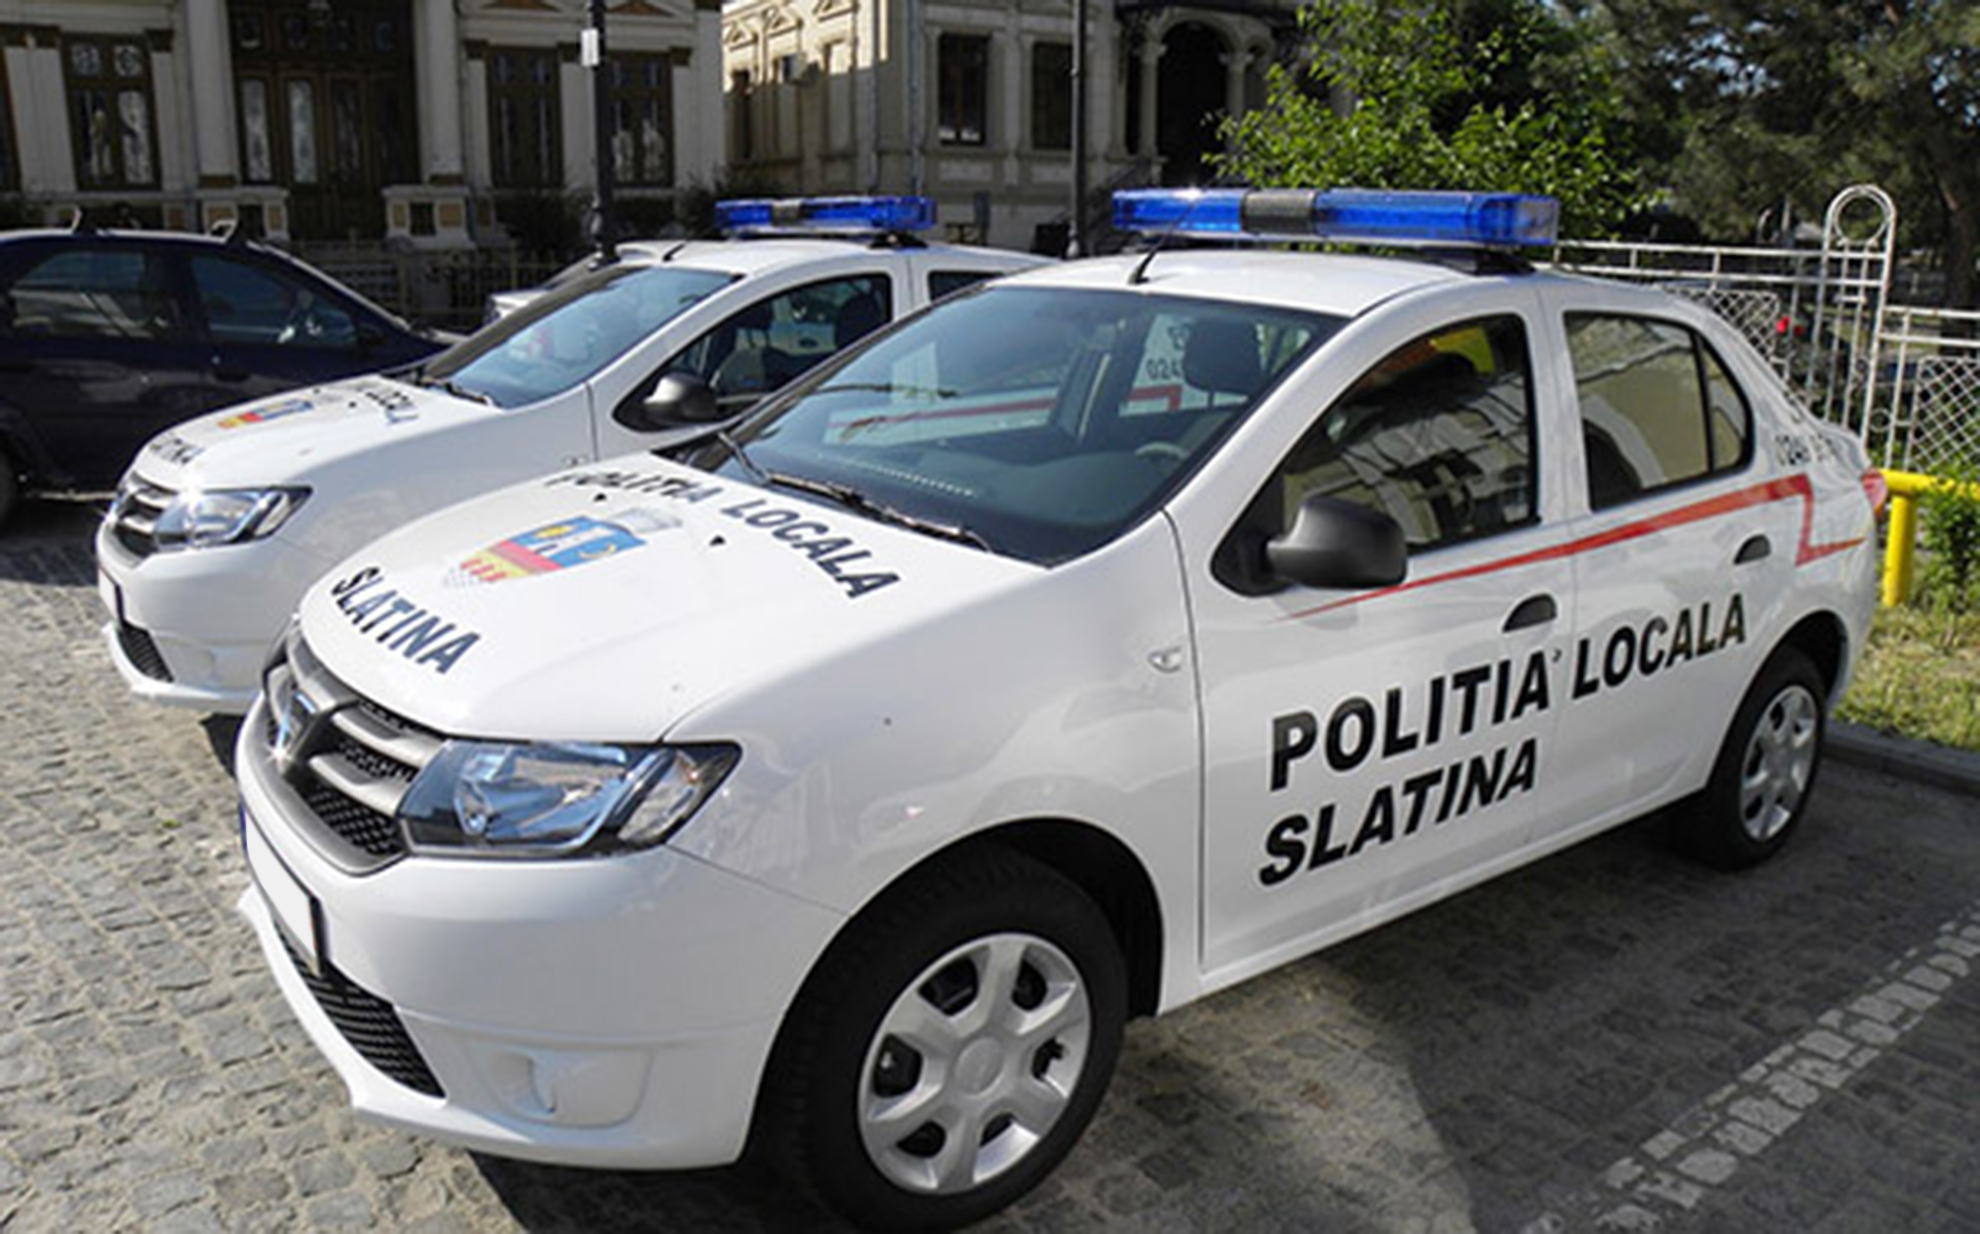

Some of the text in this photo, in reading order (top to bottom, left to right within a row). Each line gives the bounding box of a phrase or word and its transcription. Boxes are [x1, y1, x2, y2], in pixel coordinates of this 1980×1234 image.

[720, 499, 900, 599] LOCALA
[331, 567, 480, 674] SLATINA
[1269, 593, 1746, 791] POLITIA LOCALA
[1258, 738, 1538, 886] SLATINA
